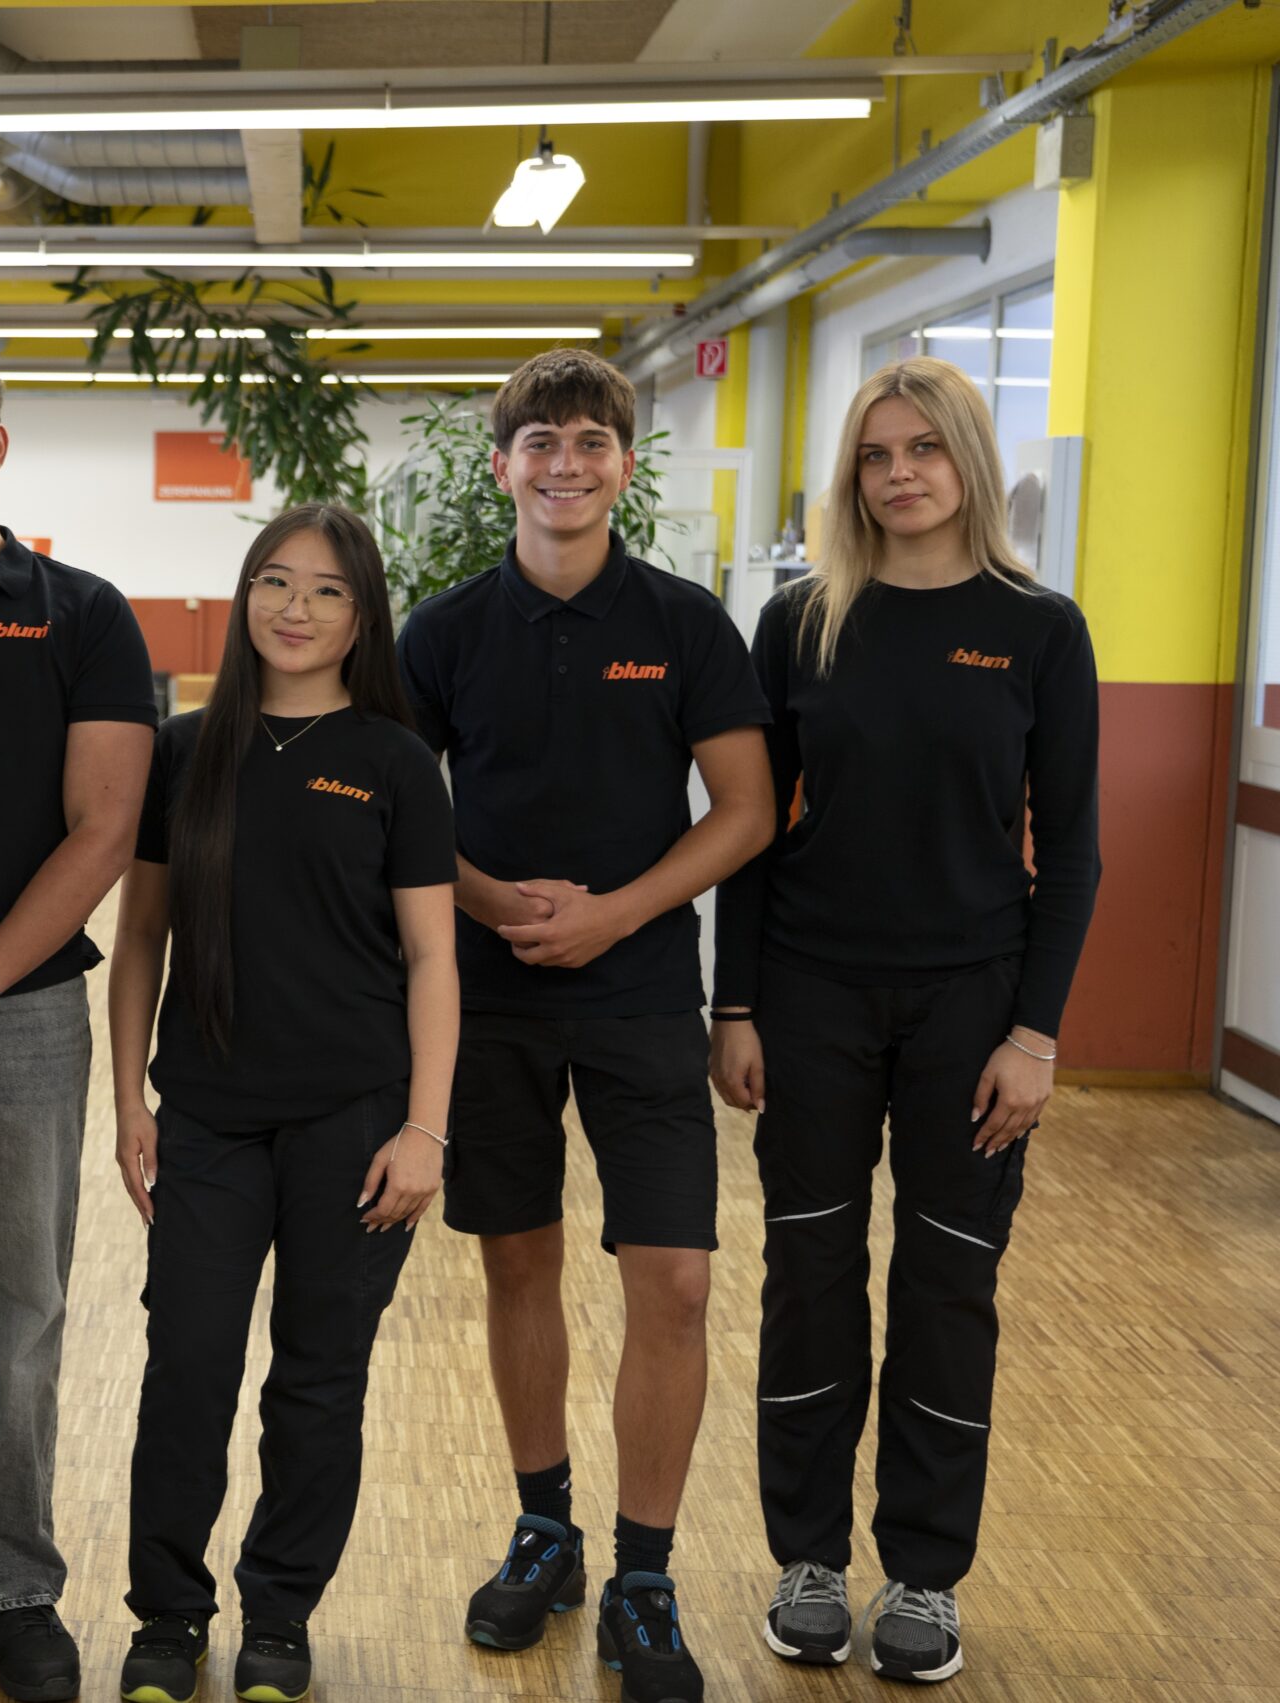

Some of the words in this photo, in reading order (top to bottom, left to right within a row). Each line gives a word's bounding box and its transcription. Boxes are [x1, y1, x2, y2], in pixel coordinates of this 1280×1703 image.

[951, 647, 1010, 669] blum
[607, 661, 666, 679] blum
[311, 776, 370, 802] blum
